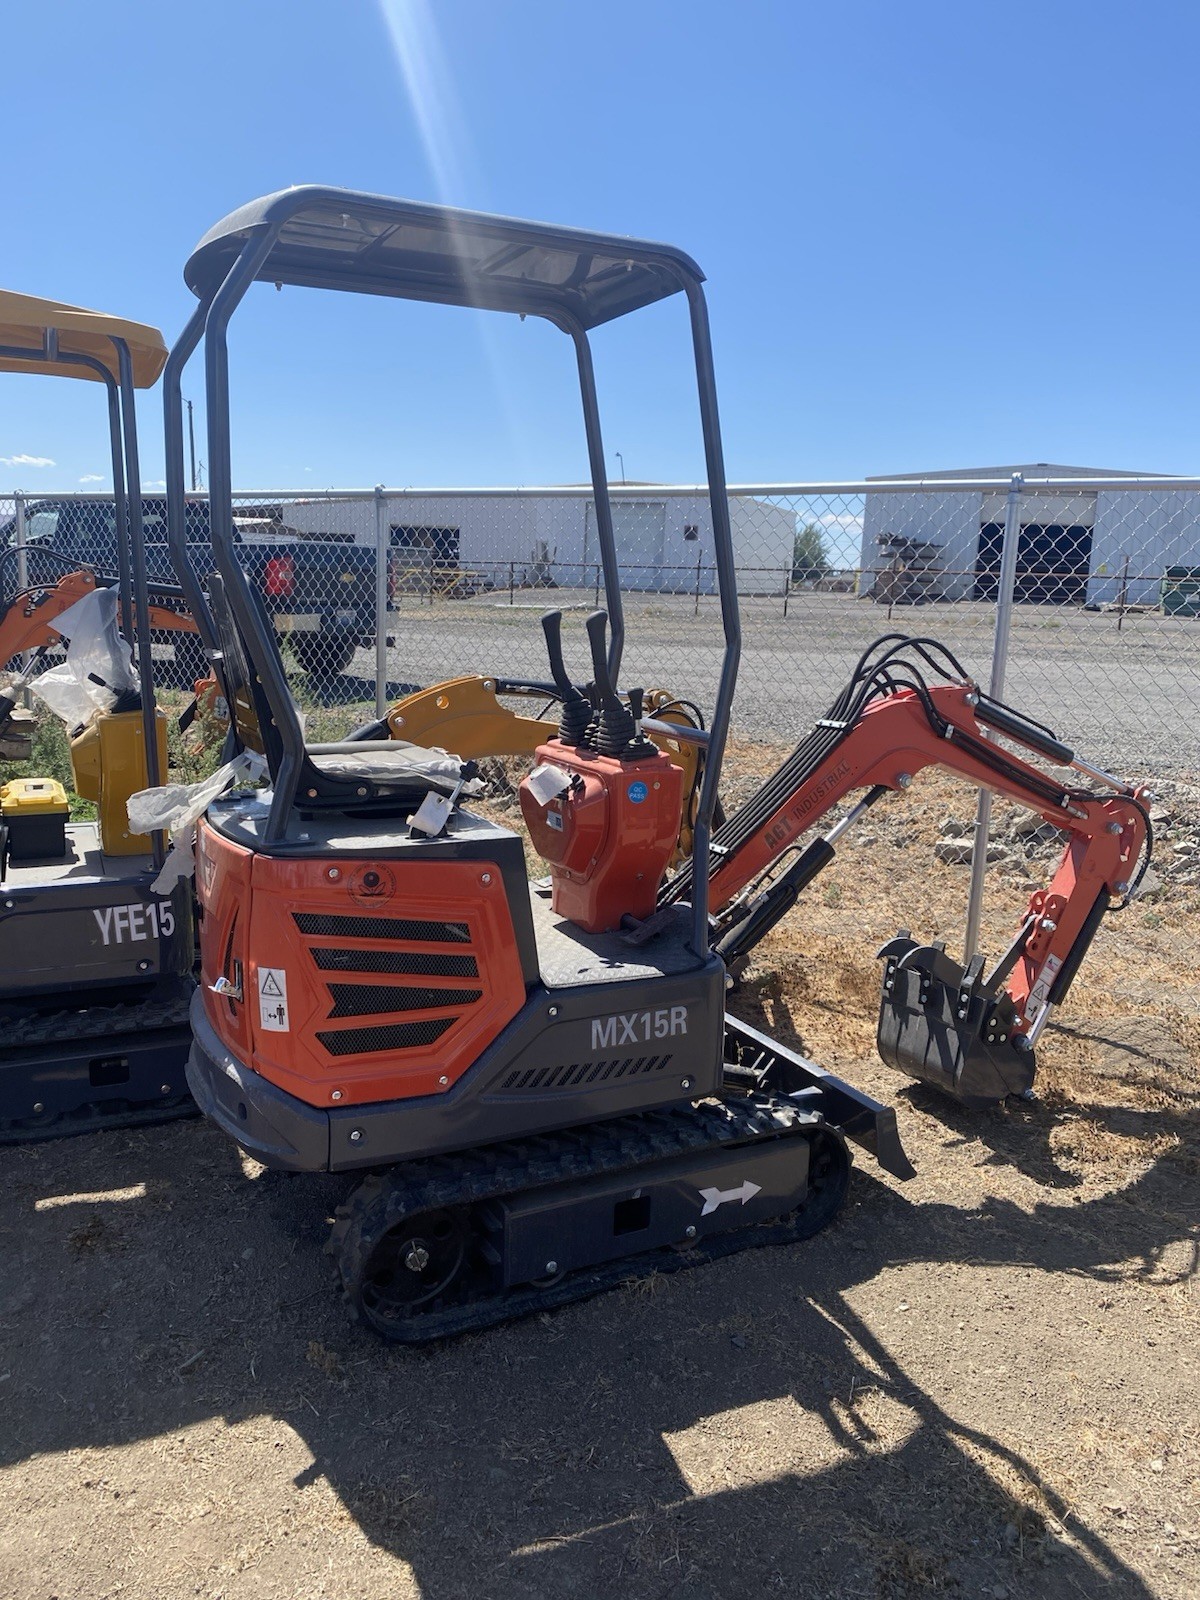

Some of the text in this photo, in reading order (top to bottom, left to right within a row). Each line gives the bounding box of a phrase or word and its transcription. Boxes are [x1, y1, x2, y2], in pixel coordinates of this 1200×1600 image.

[764, 760, 851, 850] AGT INDUSTRIAL
[93, 900, 175, 946] YFE15
[591, 1006, 688, 1050] MX15R
